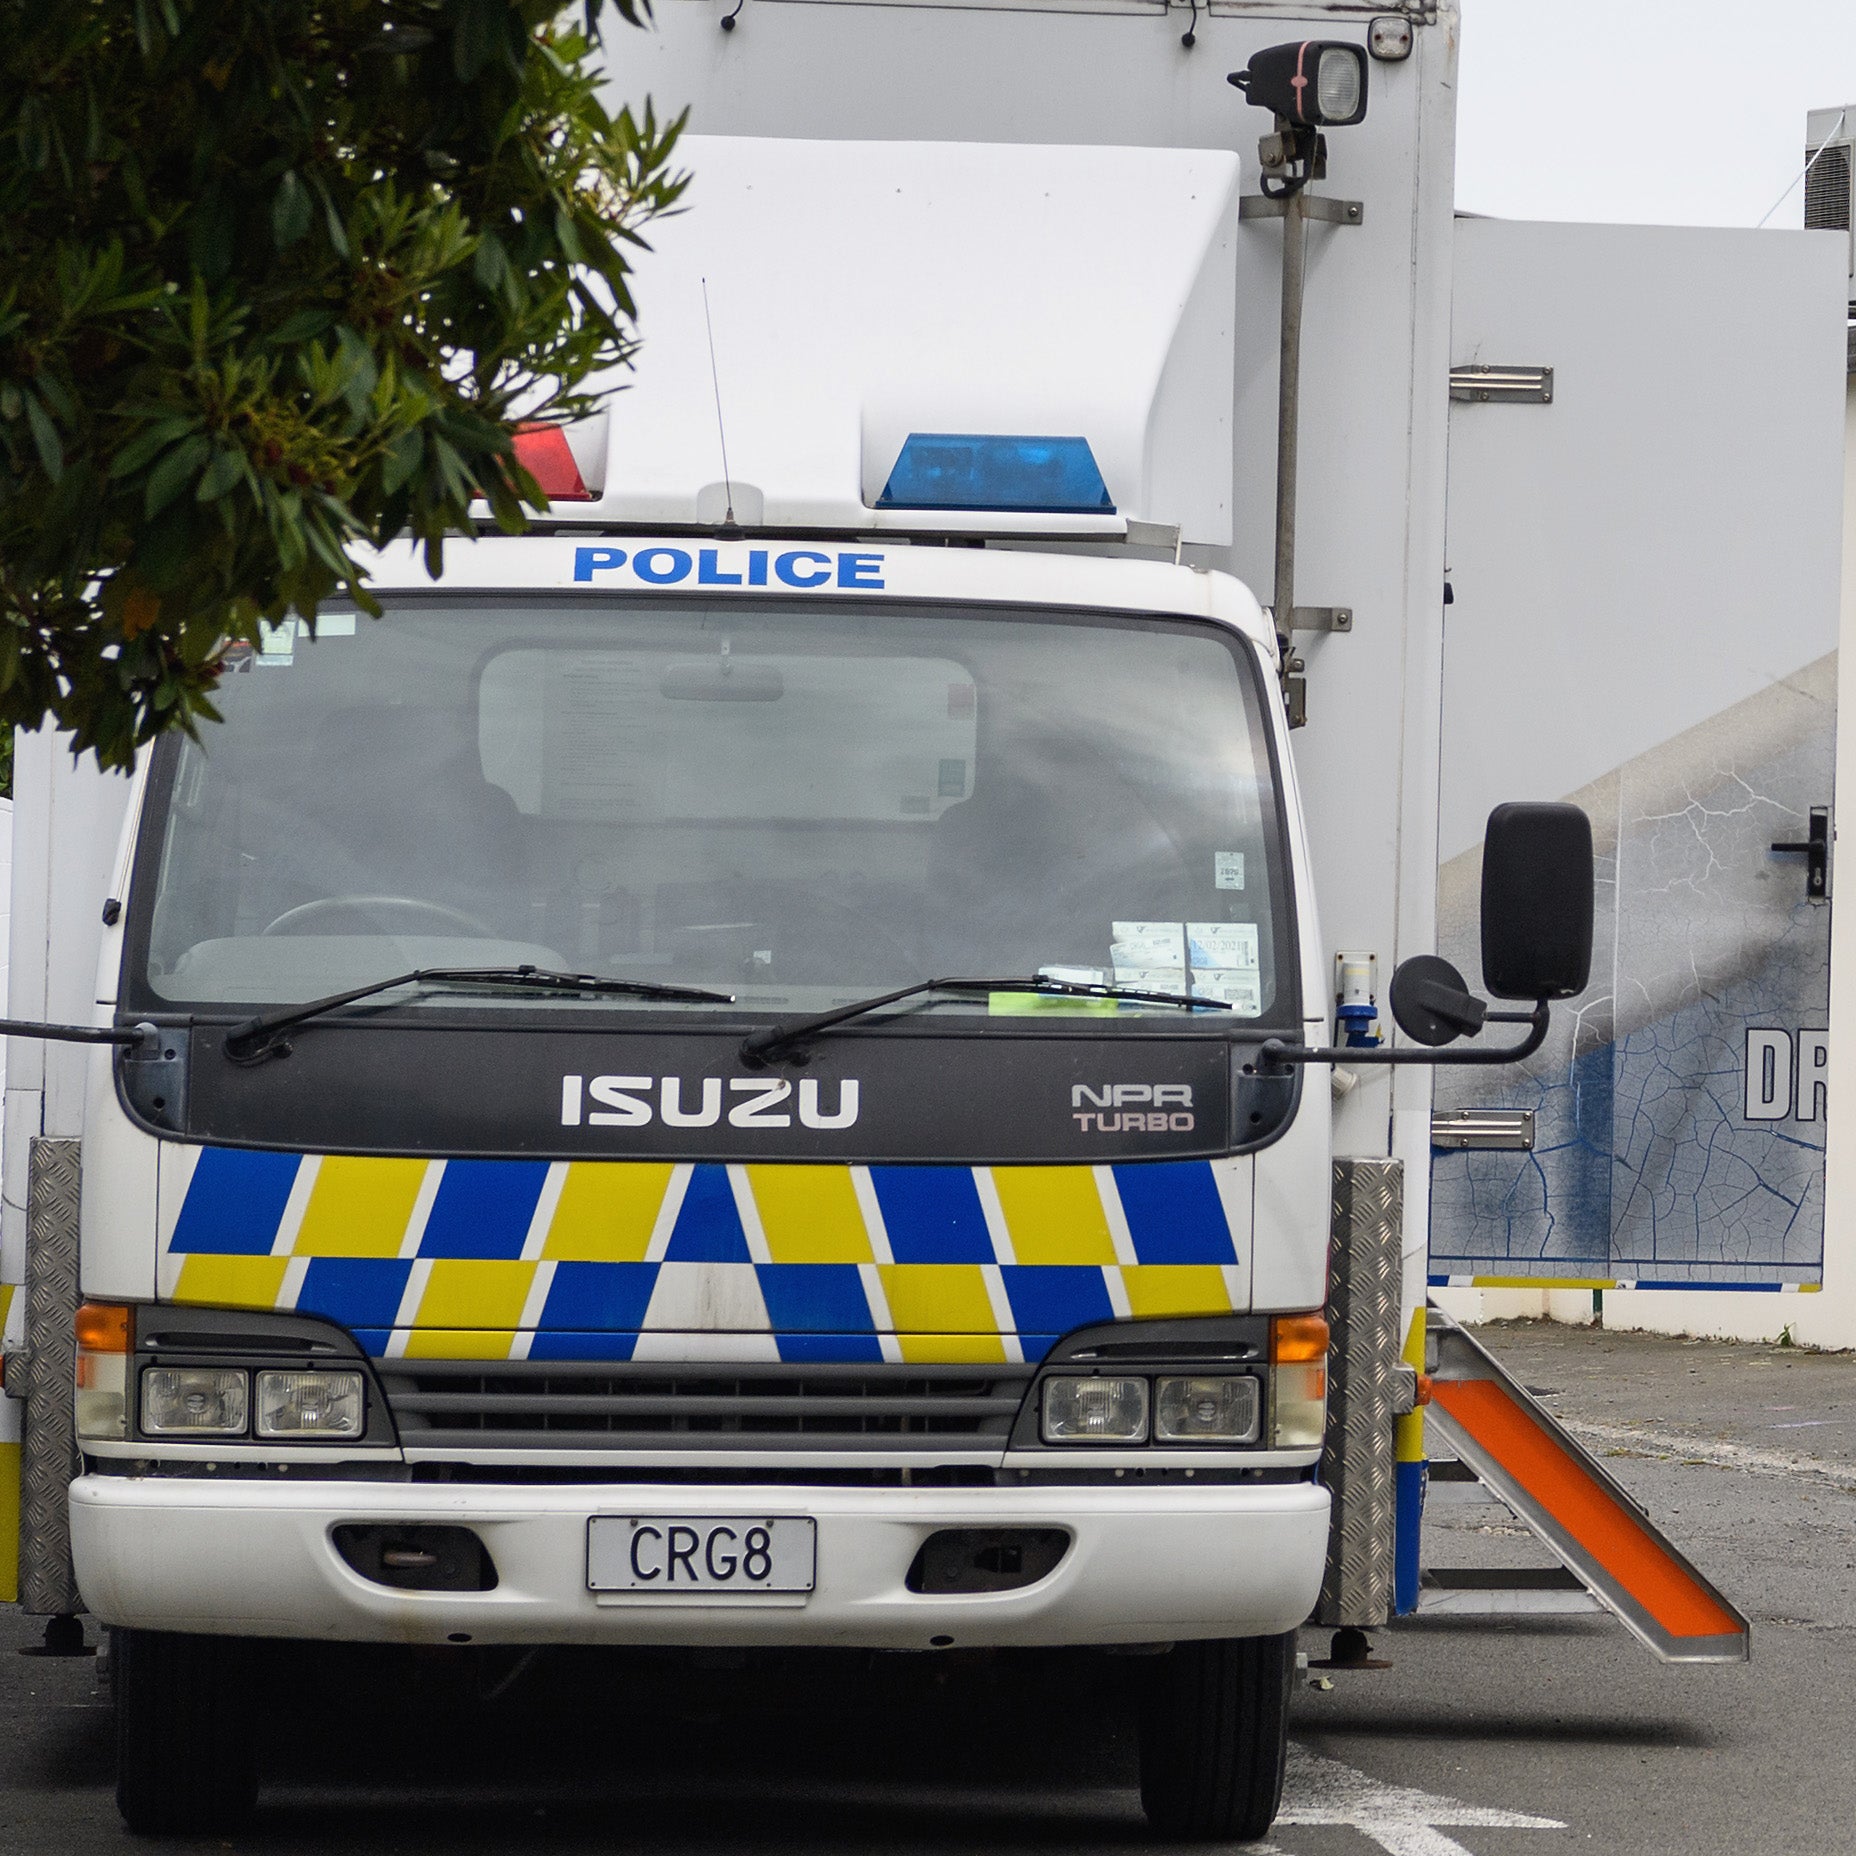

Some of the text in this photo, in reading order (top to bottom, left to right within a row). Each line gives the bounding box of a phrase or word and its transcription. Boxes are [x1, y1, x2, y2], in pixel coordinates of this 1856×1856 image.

[574, 547, 885, 589] POLICE
[561, 1075, 860, 1129] ISUZU
[1071, 1084, 1194, 1108] NPR
[1072, 1112, 1195, 1132] TURBO
[630, 1526, 773, 1581] CRG8
